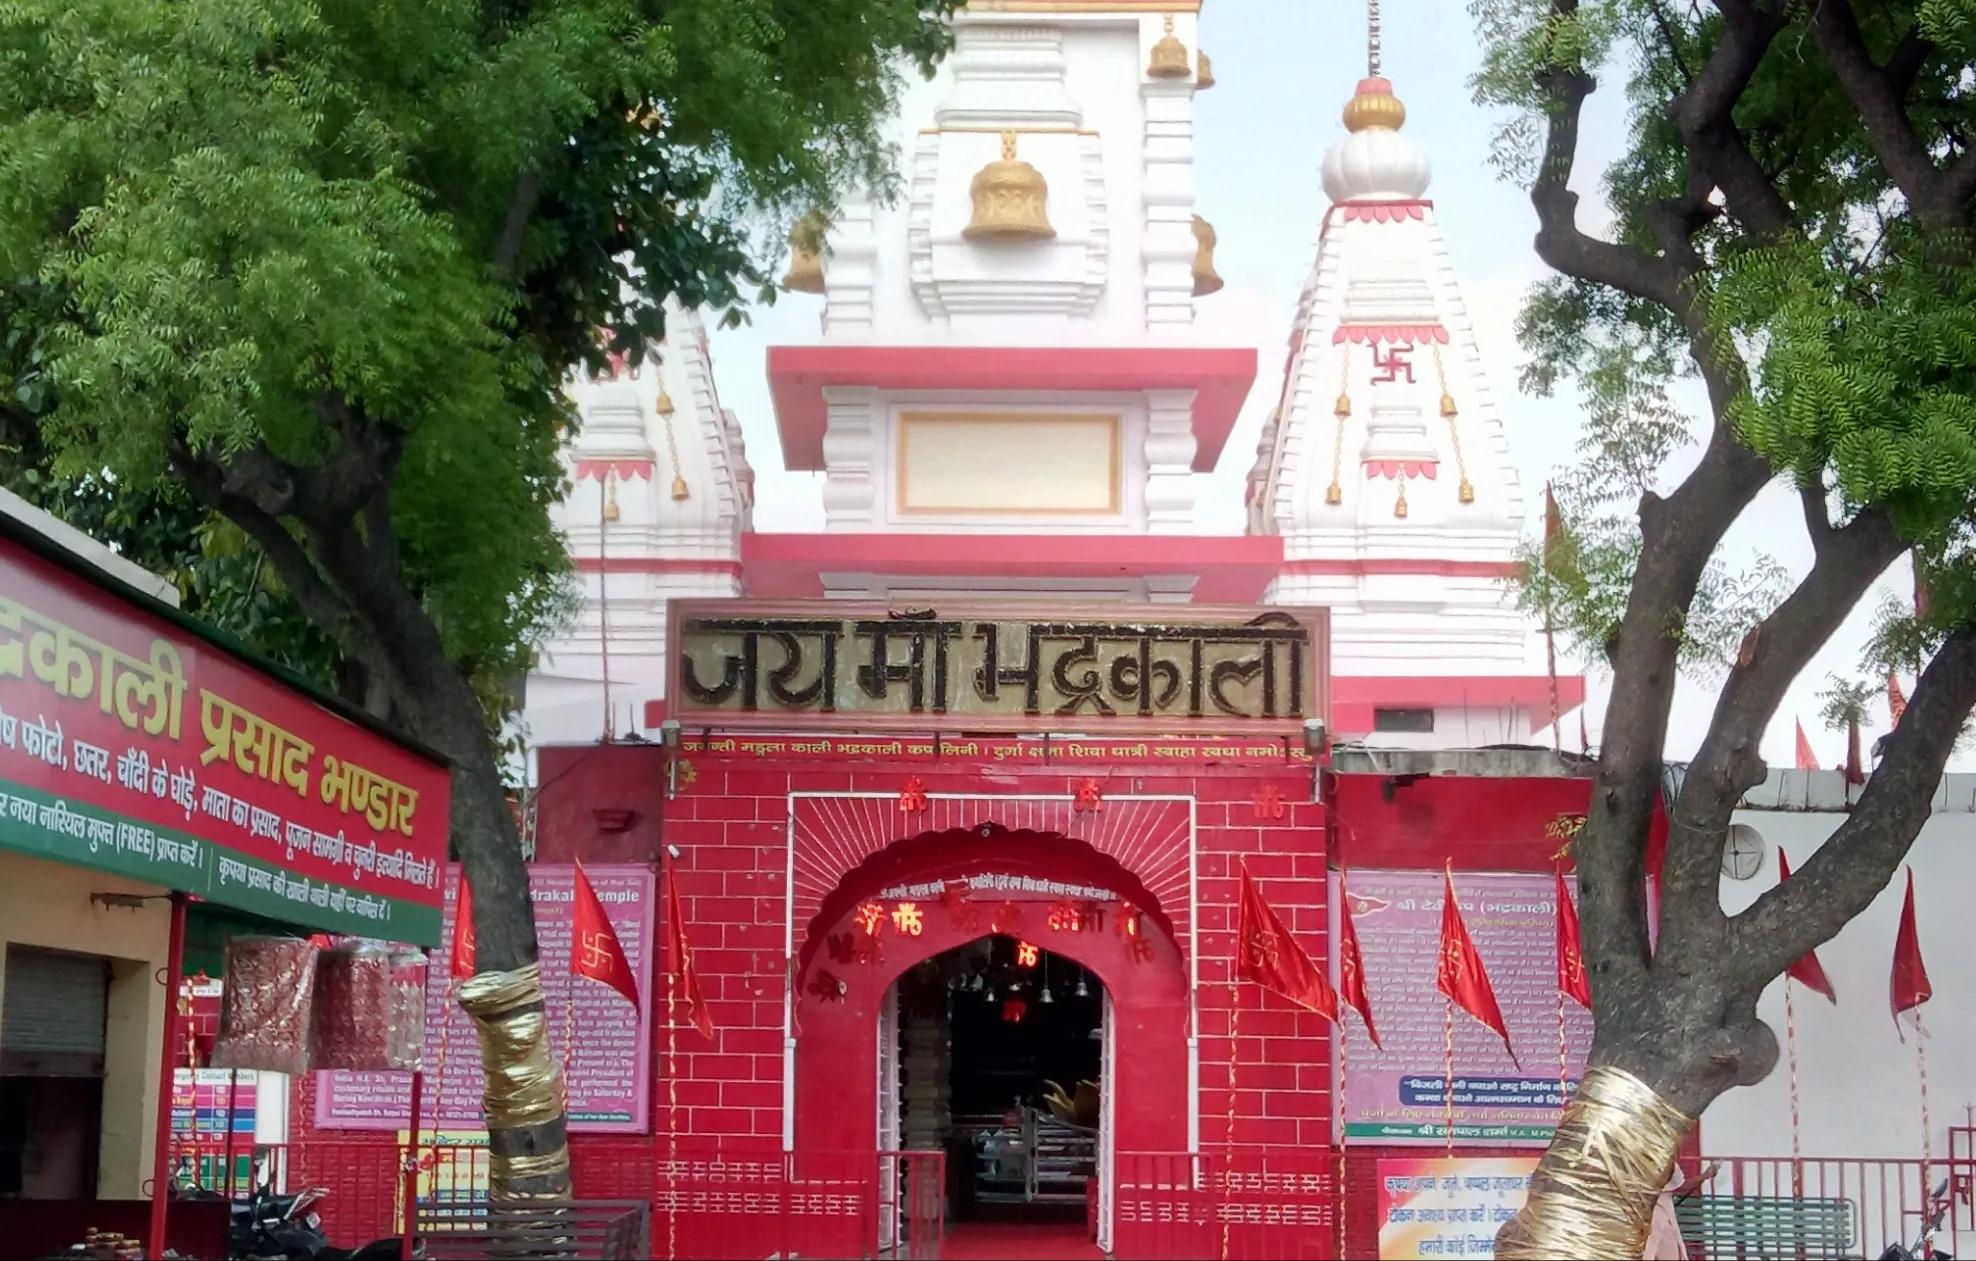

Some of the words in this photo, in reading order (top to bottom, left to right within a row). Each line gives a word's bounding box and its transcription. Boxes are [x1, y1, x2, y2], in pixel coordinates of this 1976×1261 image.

[682, 618, 844, 712] जय
[974, 611, 1309, 717] भद्रकाली
[21, 714, 68, 770] फोटो,
[74, 739, 112, 784] छतर,
[152, 759, 168, 798] के
[202, 786, 229, 821] माता
[232, 797, 250, 829] का
[199, 687, 315, 799] प्रसाद
[320, 754, 419, 838] भण्डार
[791, 739, 831, 753] काली
[837, 741, 901, 755] भद्रकाली
[907, 741, 978, 756] कपलिनी
[993, 743, 1023, 760] दुर्गा
[1069, 743, 1106, 758] शिवा
[10, 796, 37, 825] नया
[116, 821, 155, 861] (FREE)
[597, 889, 639, 904] emple
